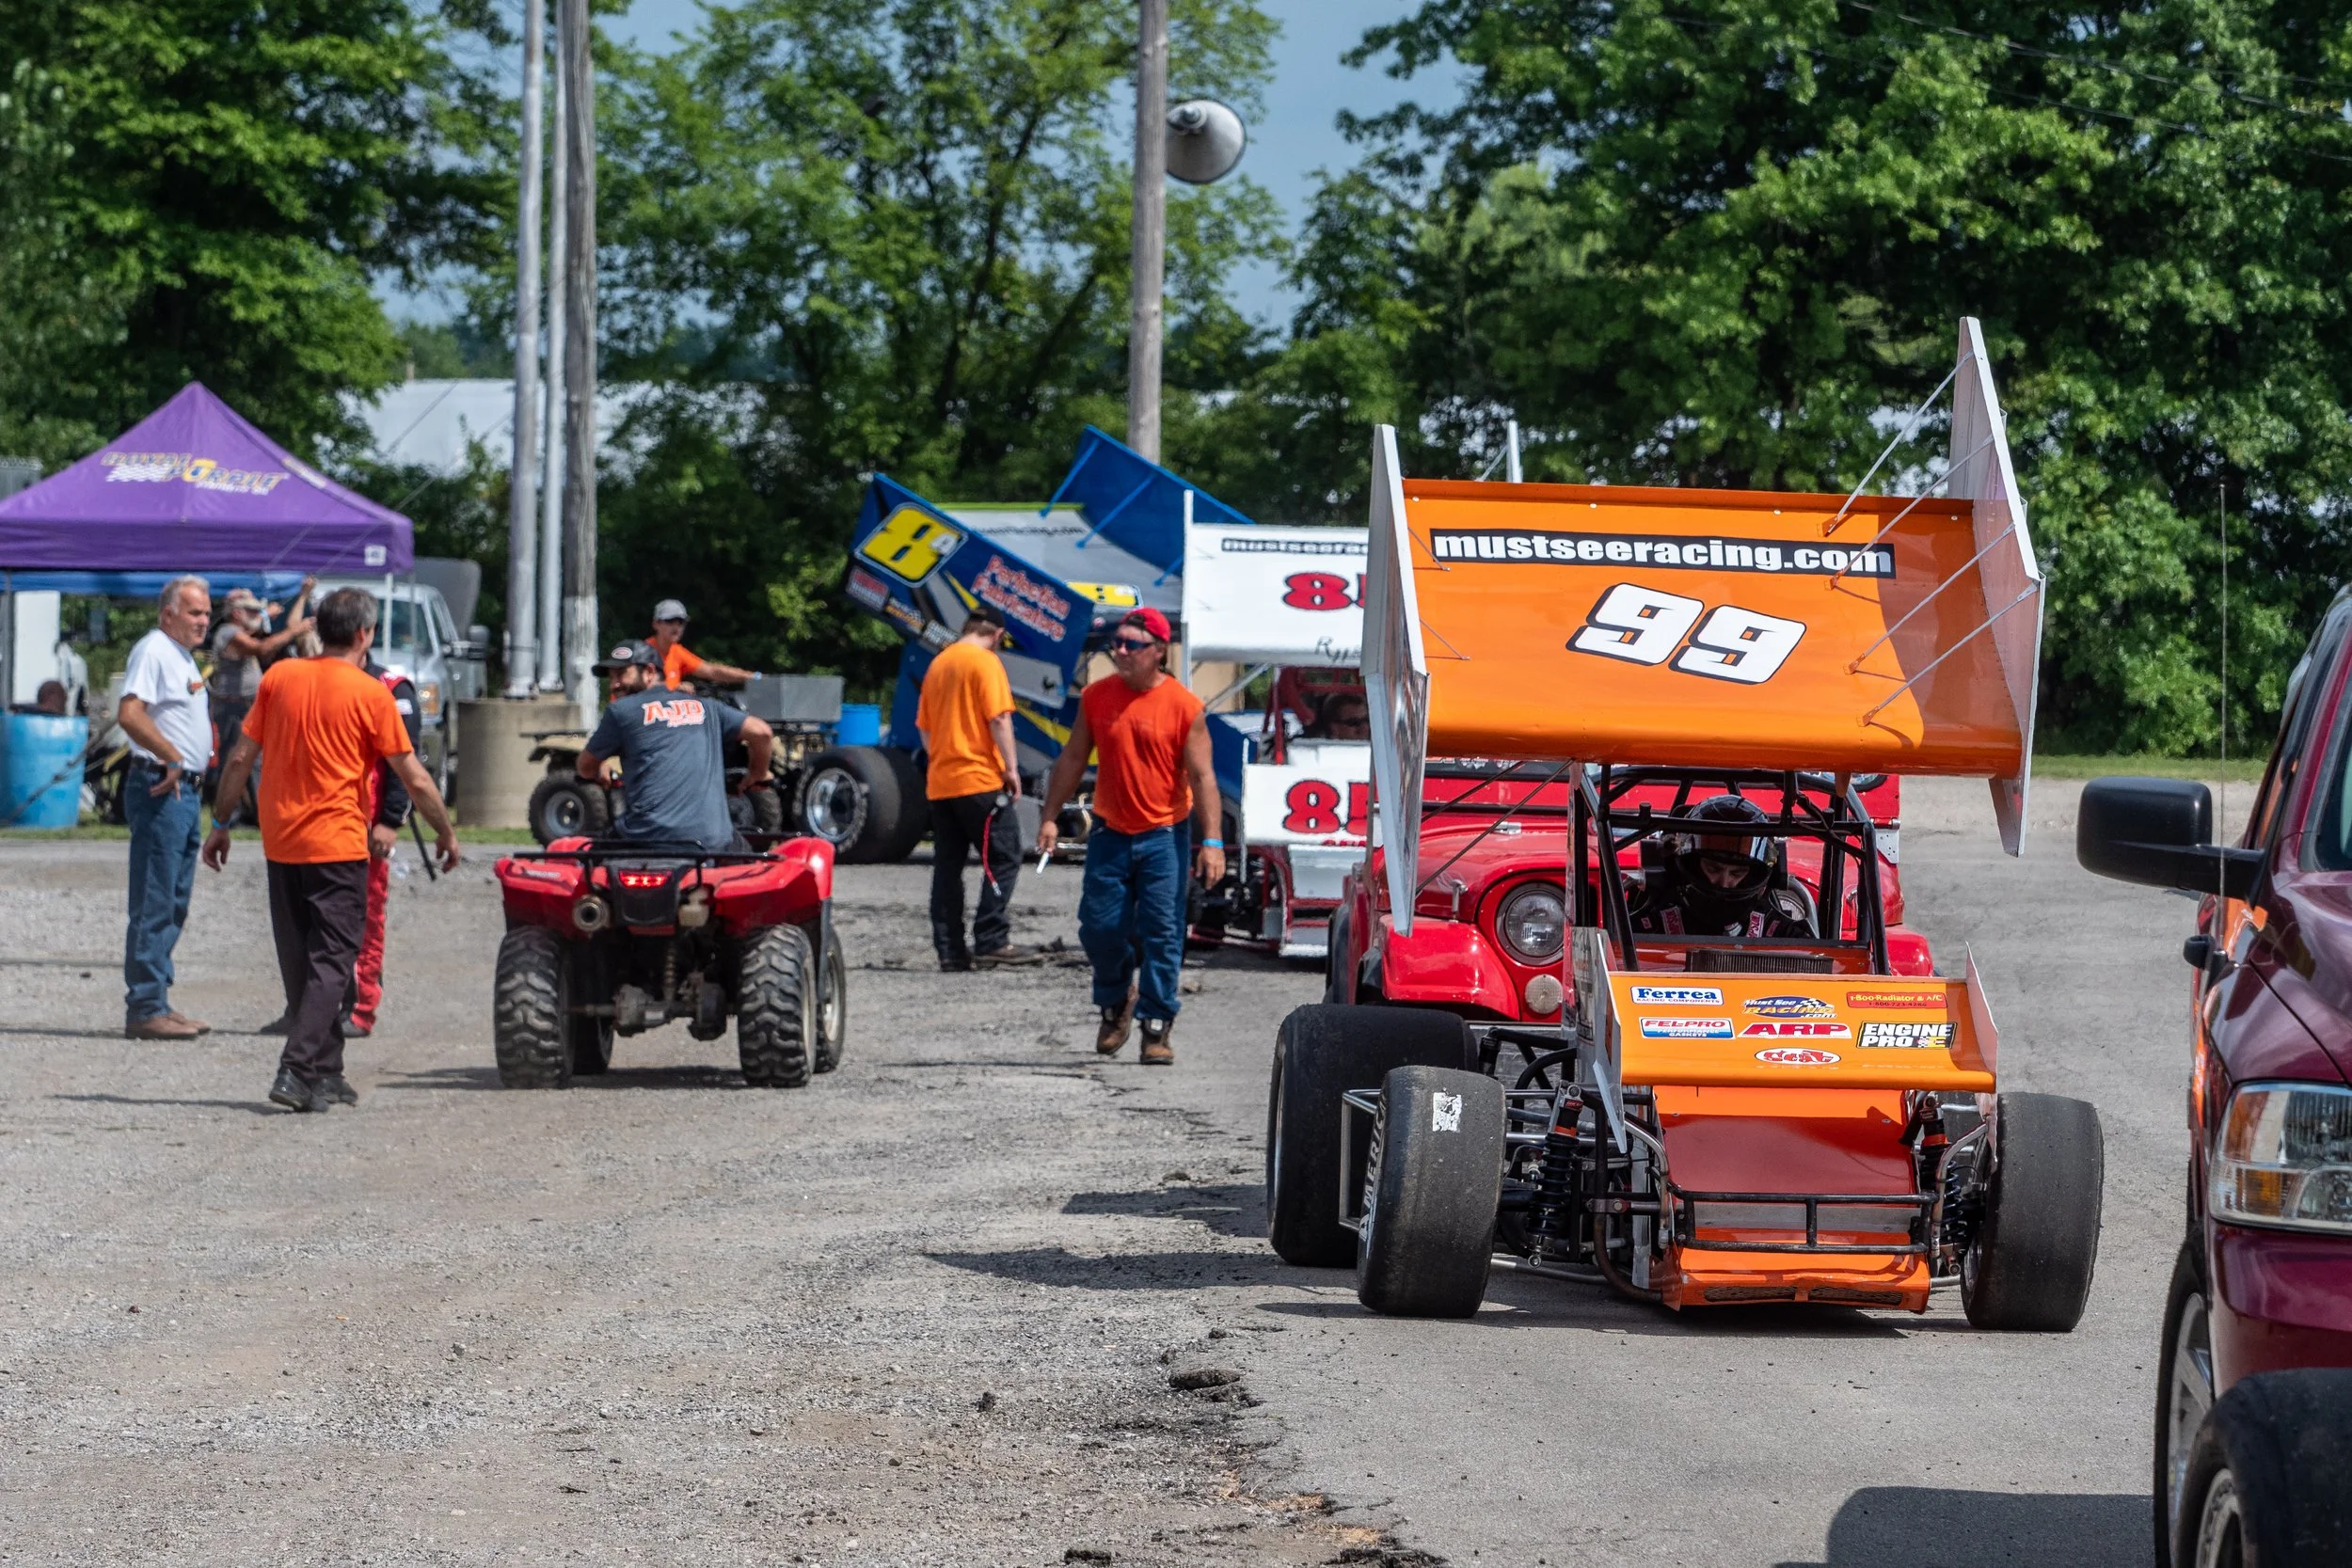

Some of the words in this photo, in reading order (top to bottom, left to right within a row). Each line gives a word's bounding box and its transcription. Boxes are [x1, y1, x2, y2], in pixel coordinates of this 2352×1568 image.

[1433, 533, 1893, 574] mustseeracing.com
[1282, 571, 1367, 611] 8
[1566, 582, 1807, 686] 99
[1637, 988, 1717, 999] Ferrea
[1744, 998, 1772, 1006] Must
[1743, 1006, 1834, 1015] RACING
[1743, 1023, 1847, 1035] ARP
[1864, 1023, 1952, 1037] ENGINE
[1861, 1036, 1915, 1047] PRO
